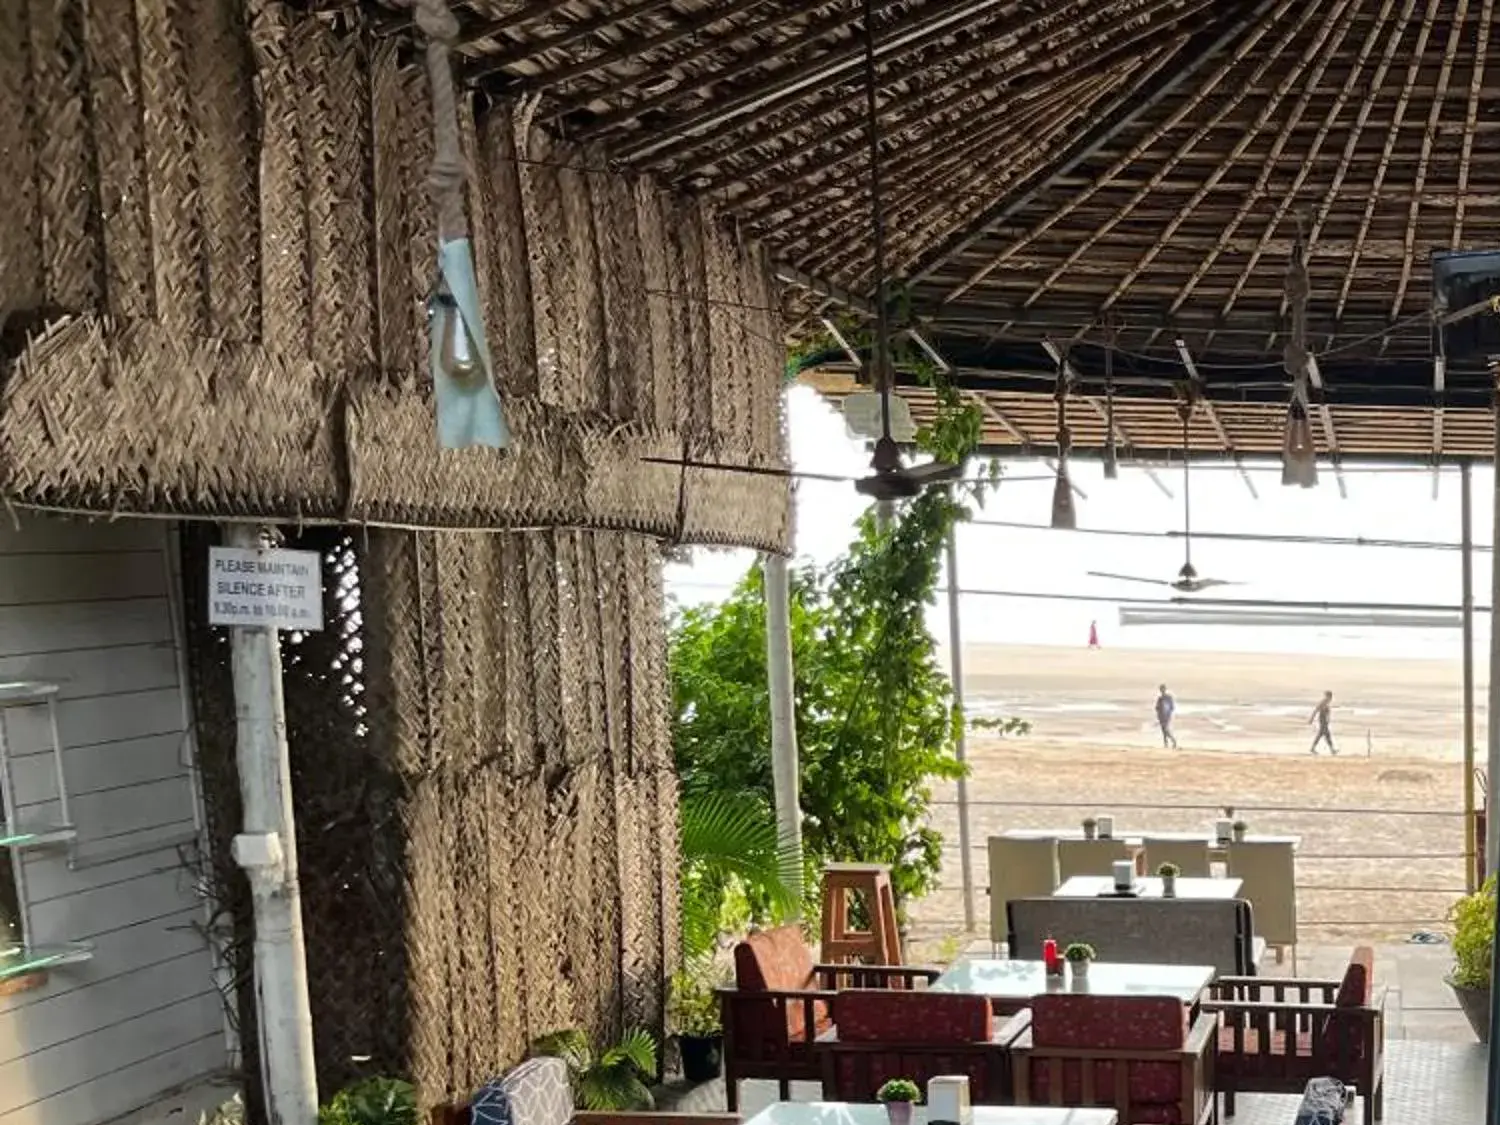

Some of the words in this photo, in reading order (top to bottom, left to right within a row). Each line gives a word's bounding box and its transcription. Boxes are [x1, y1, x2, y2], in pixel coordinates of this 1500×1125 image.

[215, 559, 255, 574] PLEASE
[257, 561, 309, 576] MAINTAIN
[217, 581, 266, 597] SILENCE
[267, 584, 305, 599] AFTER
